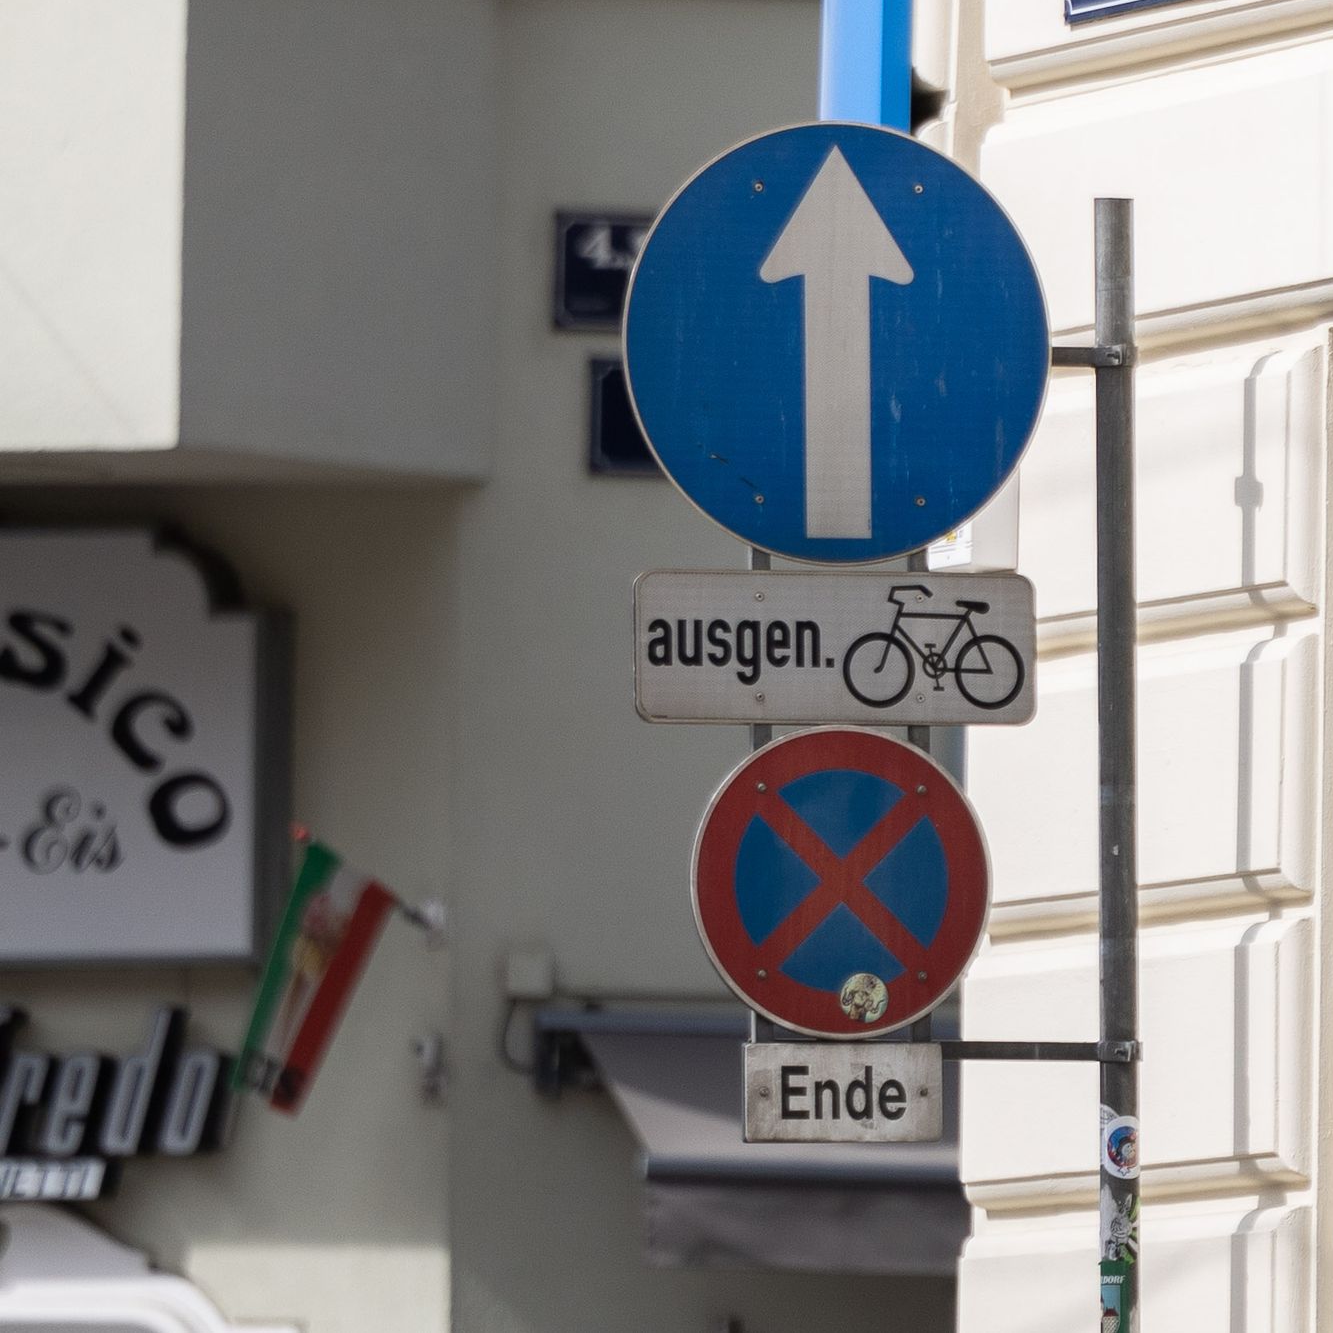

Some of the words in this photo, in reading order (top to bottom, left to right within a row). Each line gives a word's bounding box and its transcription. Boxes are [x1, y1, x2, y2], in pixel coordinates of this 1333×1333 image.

[647, 617, 835, 685] ausgen.
[0, 1005, 221, 1157] redo
[780, 1065, 908, 1121] Ende
